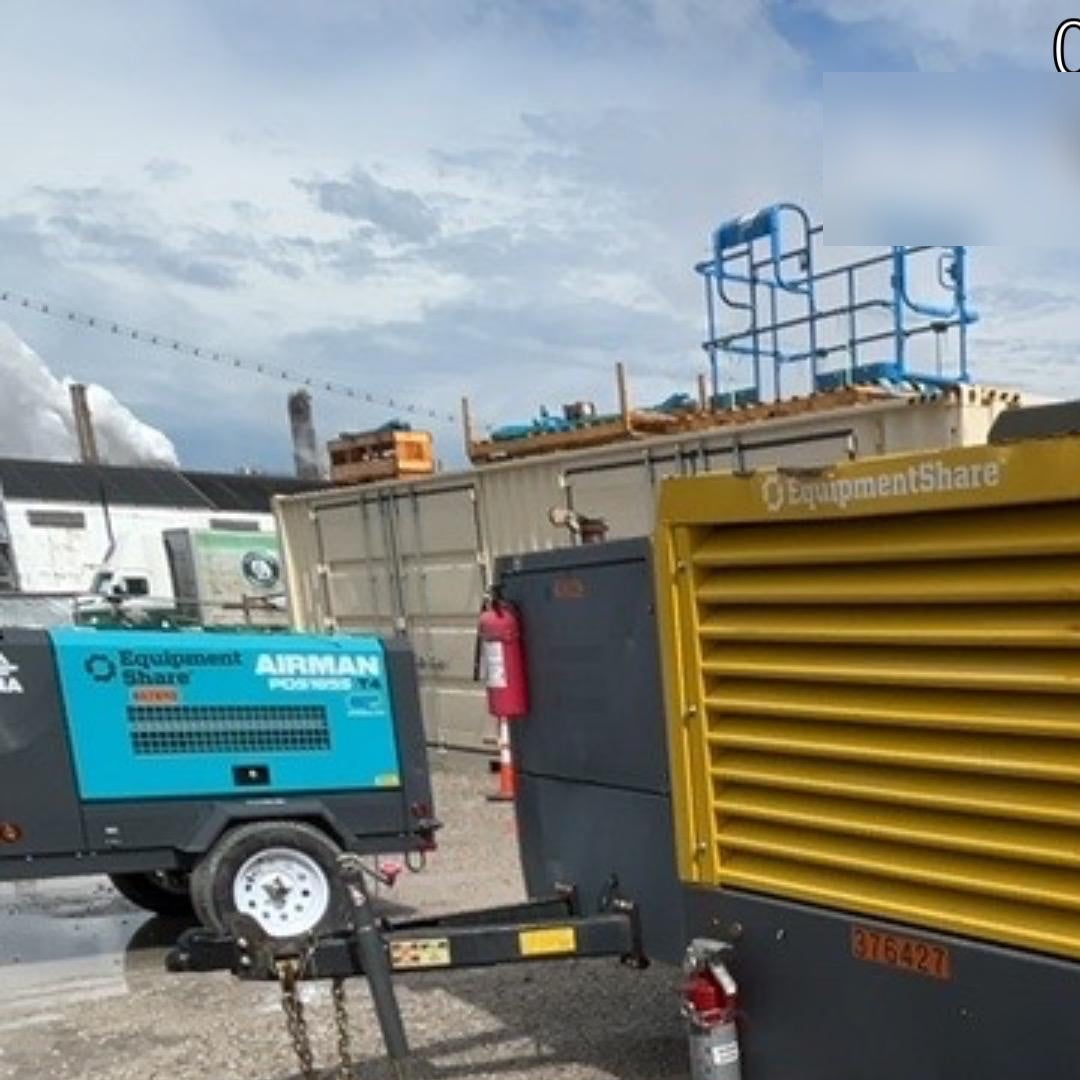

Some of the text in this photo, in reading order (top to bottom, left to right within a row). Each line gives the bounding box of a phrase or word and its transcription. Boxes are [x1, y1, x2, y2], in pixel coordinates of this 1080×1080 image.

[787, 462, 999, 511] EquipmentShare
[120, 650, 242, 669] Equipment
[255, 652, 380, 676] AIRMAN
[122, 669, 190, 687] Share
[854, 929, 949, 975] 376427
